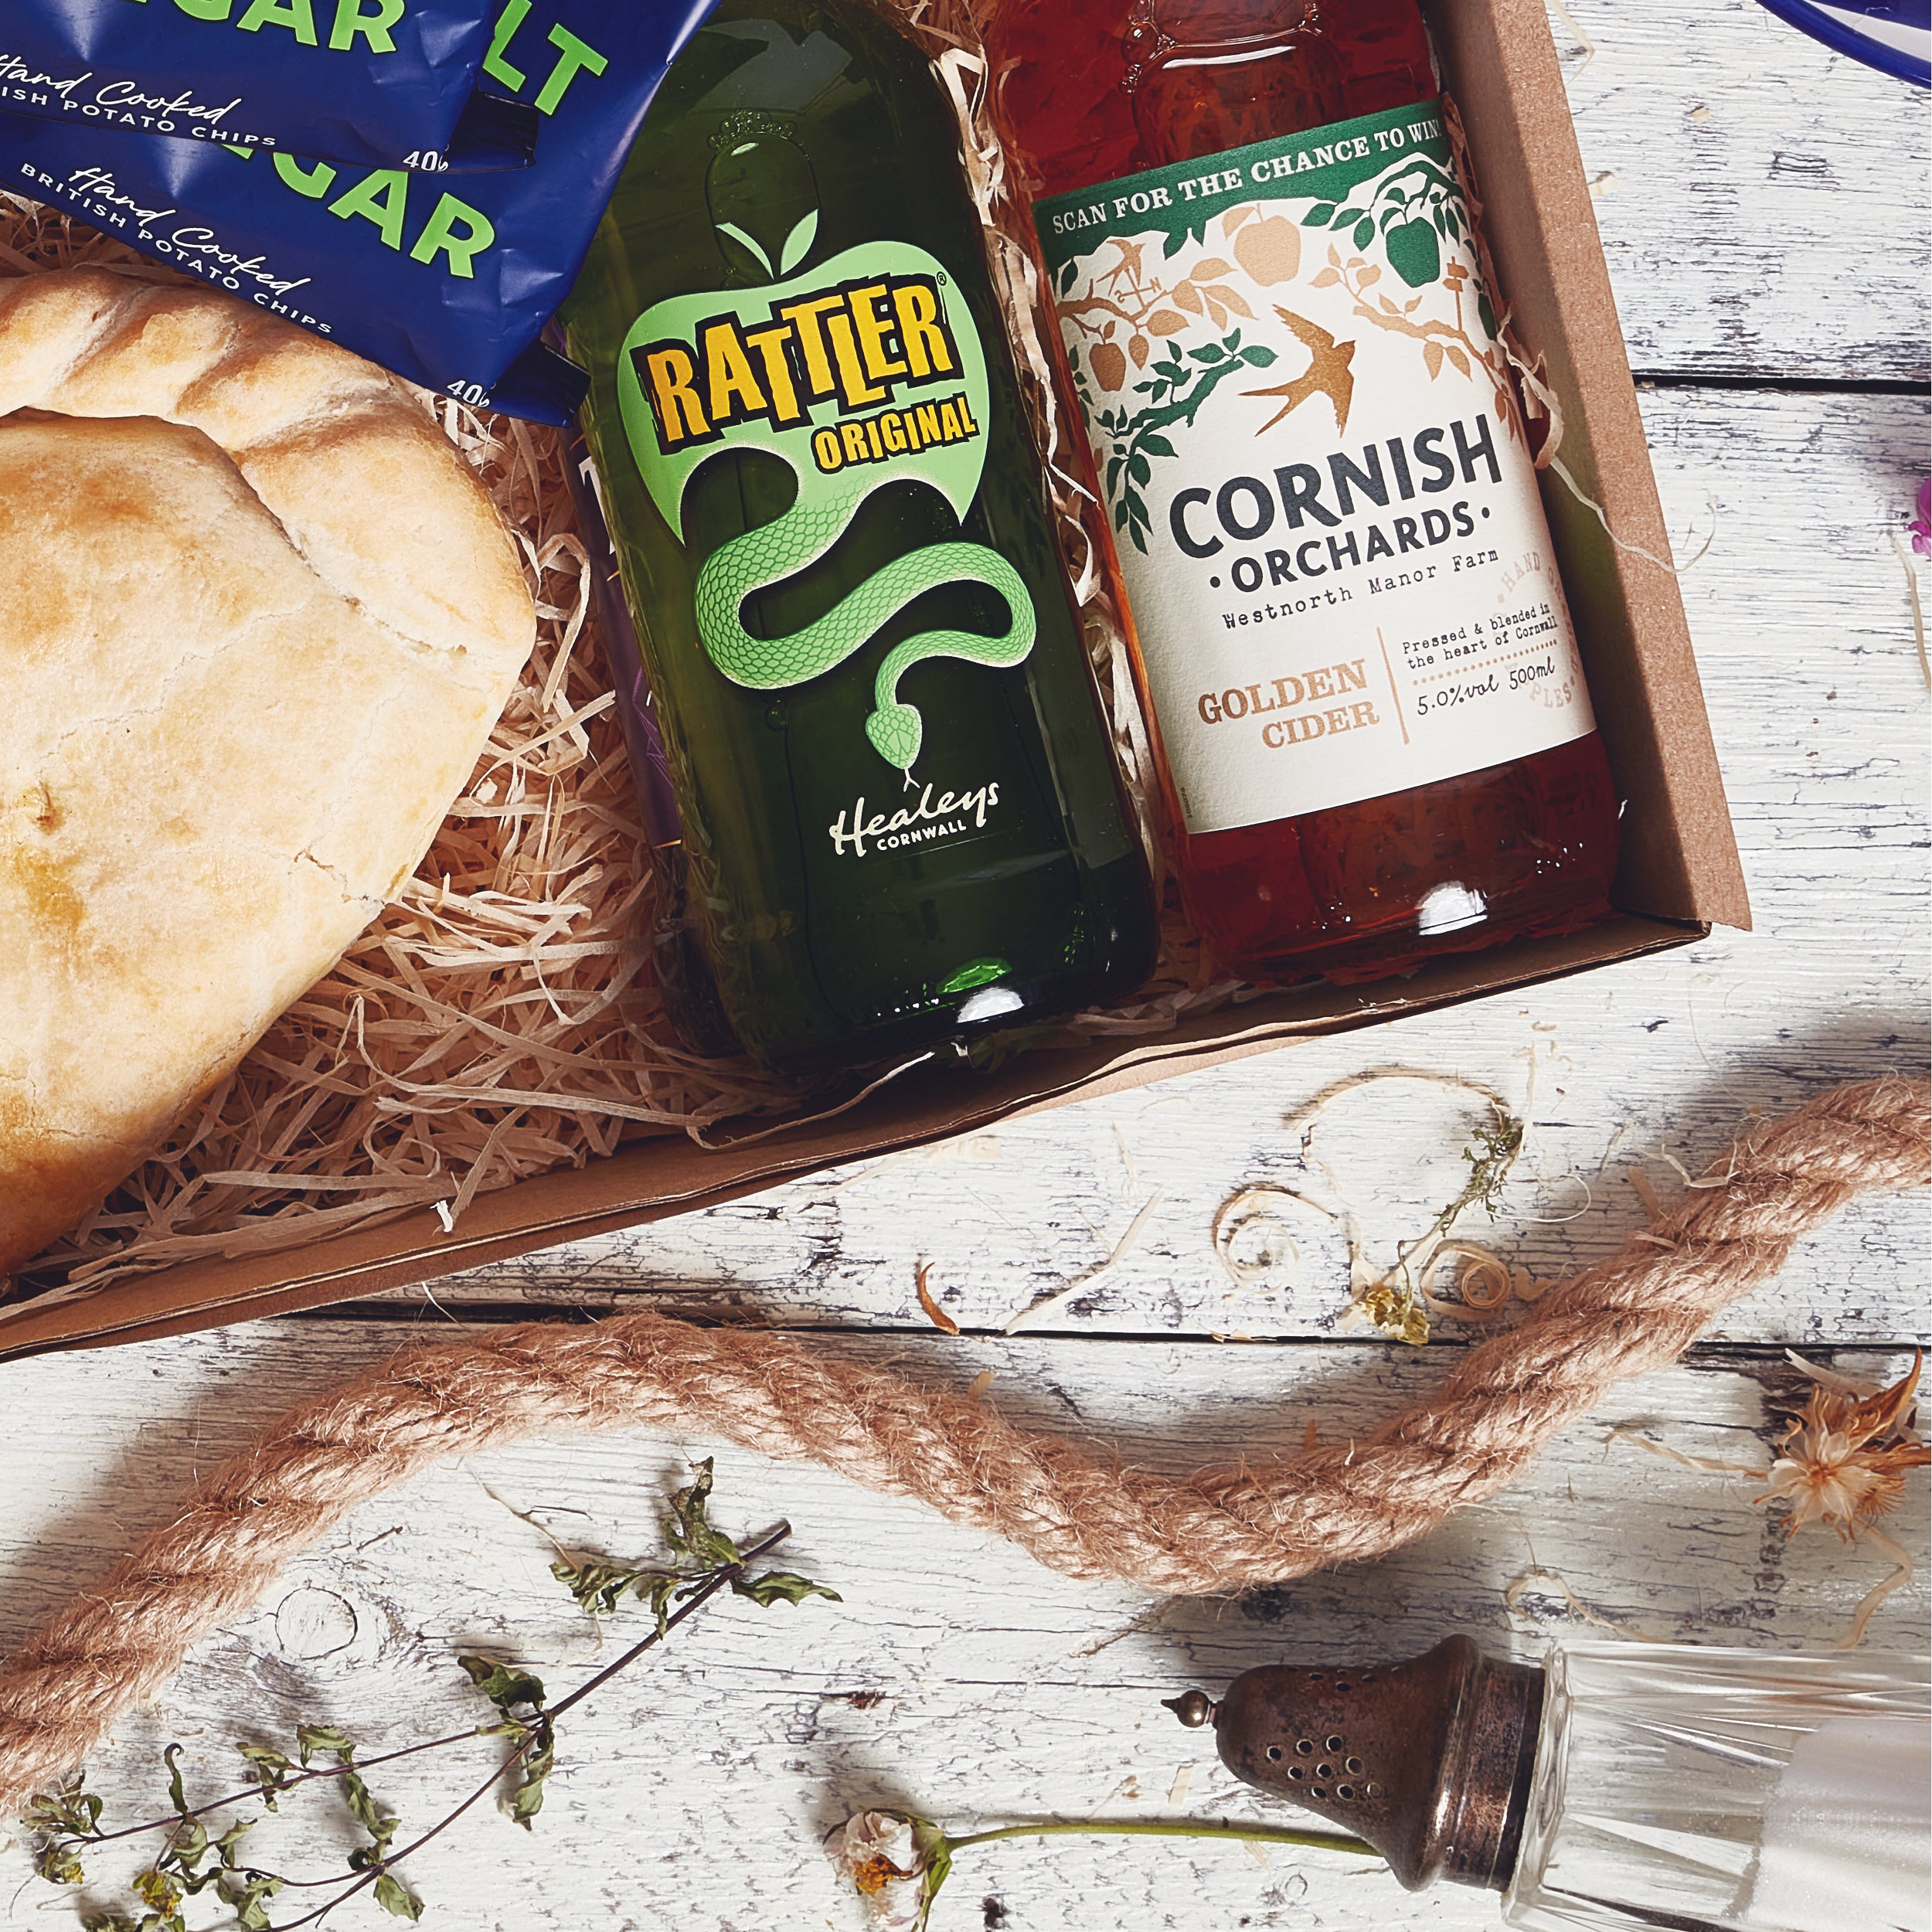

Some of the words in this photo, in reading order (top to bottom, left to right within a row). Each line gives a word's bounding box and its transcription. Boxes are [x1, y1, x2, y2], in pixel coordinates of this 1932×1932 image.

[0, 55, 92, 103] Hand
[97, 82, 241, 124] Cooked
[483, 0, 607, 115] LT
[2, 87, 47, 105] ISH
[64, 100, 175, 131] POTATO
[192, 127, 275, 145] CHIPS
[1053, 203, 1107, 233] SCAN
[1113, 188, 1172, 218] FOR
[1178, 168, 1243, 200] THE
[1251, 136, 1369, 182] CHANCE
[1374, 128, 1404, 151] TO
[1407, 120, 1440, 143] WIN!
[22, 164, 126, 227] BRITISH
[138, 229, 239, 289] POTATO
[254, 294, 331, 332] CHIPS
[71, 168, 175, 226] Hand
[172, 228, 311, 293] Cooked
[815, 397, 975, 468] ORIGINAL
[1170, 414, 1502, 558] CORNISH
[1223, 587, 1352, 628] Westnorth
[1369, 566, 1435, 594] Manor
[1453, 550, 1498, 571] Farm
[1402, 627, 1467, 655] Pressed
[1475, 624, 1482, 634] &
[1490, 607, 1536, 629] blended
[1539, 603, 1550, 615] in
[1407, 655, 1434, 669] the
[1443, 639, 1487, 660] heart
[1495, 631, 1509, 645] of
[1515, 615, 1558, 639] Cornwall
[1199, 659, 1367, 725] GOLDEN
[1509, 655, 1555, 690] 500ml
[1263, 702, 1380, 749] CIDER
[829, 783, 998, 856] Healeys
[877, 820, 966, 850] CORNWALL
